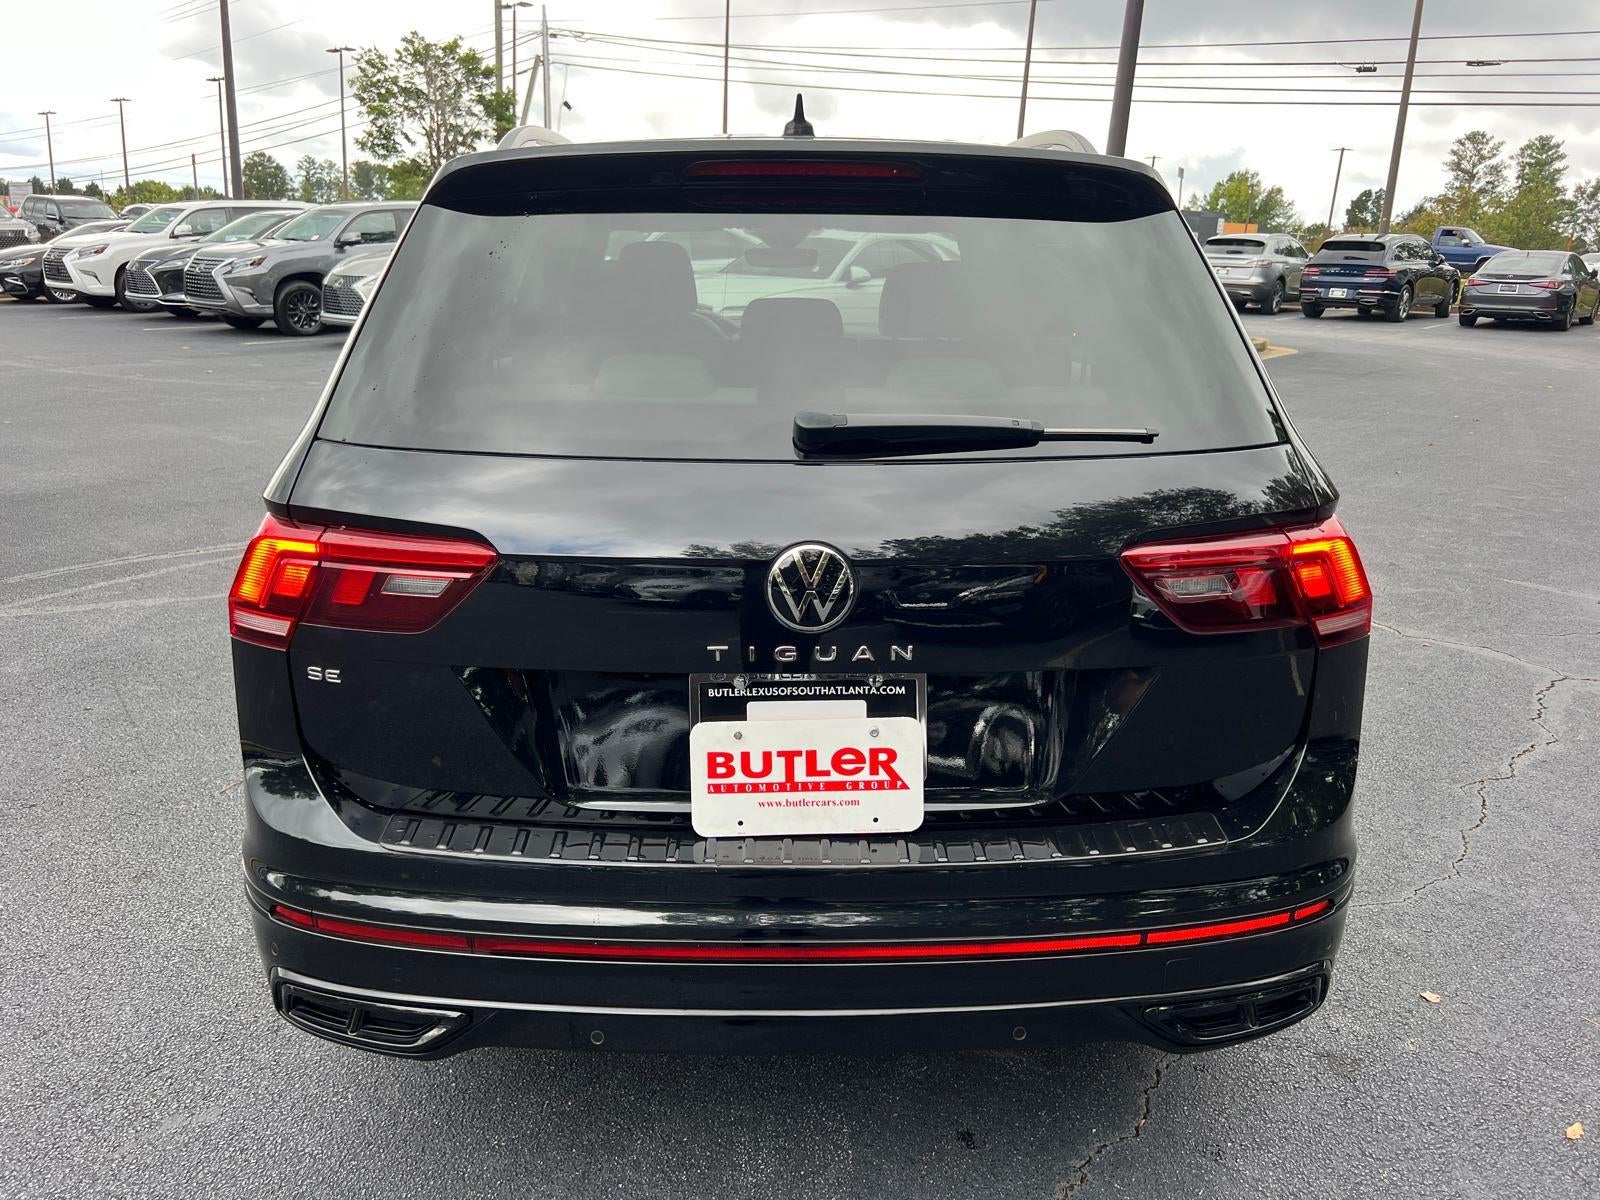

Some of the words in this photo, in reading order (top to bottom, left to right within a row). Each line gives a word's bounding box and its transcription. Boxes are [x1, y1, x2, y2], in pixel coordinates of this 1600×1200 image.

[706, 645, 914, 662] TIGUAN
[307, 666, 342, 684] SE
[708, 685, 906, 697] BUTLERLEXUSOFSOUTHATLANTA.COM
[708, 782, 826, 793] AUTOMOTIVE
[846, 780, 904, 791] GROUP
[758, 798, 860, 808] www.butlercars.com
